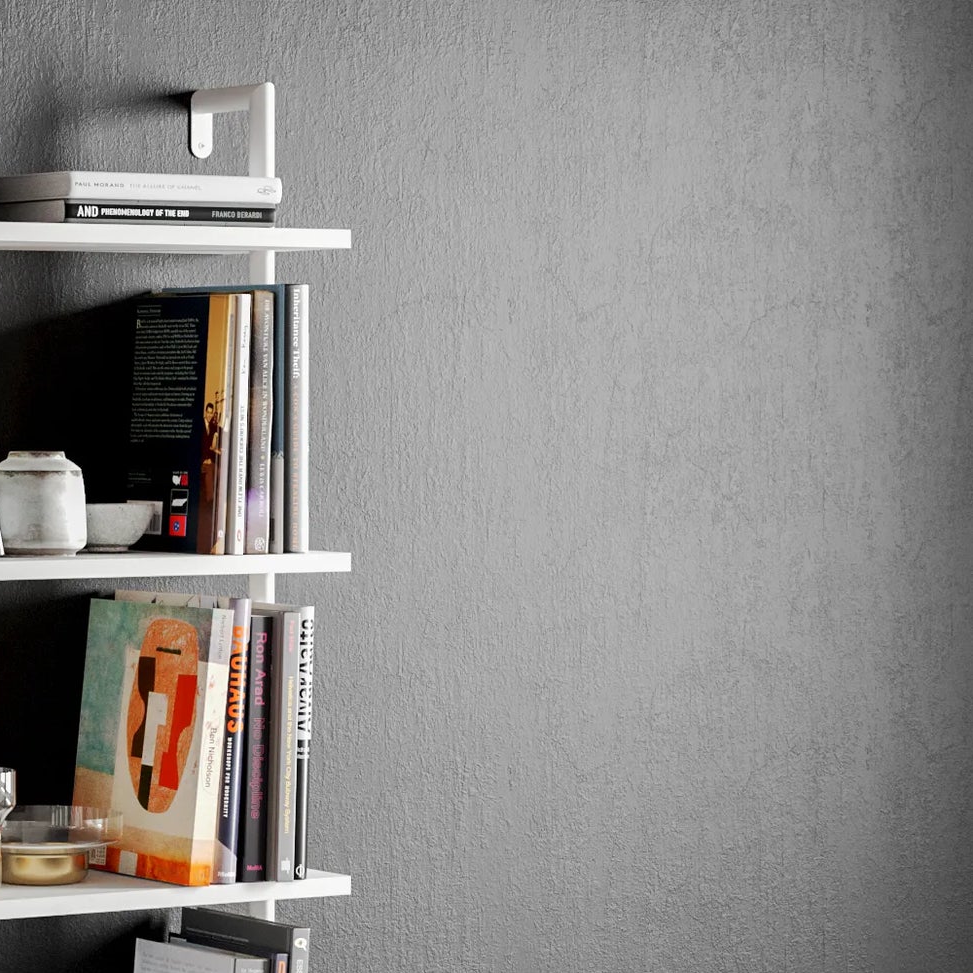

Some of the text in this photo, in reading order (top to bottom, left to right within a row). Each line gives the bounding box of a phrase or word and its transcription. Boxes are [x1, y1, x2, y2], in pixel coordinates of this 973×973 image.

[77, 205, 98, 218] AND
[100, 208, 154, 217] PHENOMENOLOGY
[156, 209, 164, 217] OF
[164, 209, 176, 217] THE
[236, 211, 263, 219] BERARDI
[262, 390, 268, 399] IN
[227, 626, 248, 733] BAUHAUS
[250, 632, 267, 819] Ron Arad No Discipline
[205, 727, 217, 787] Ben Nicholson
